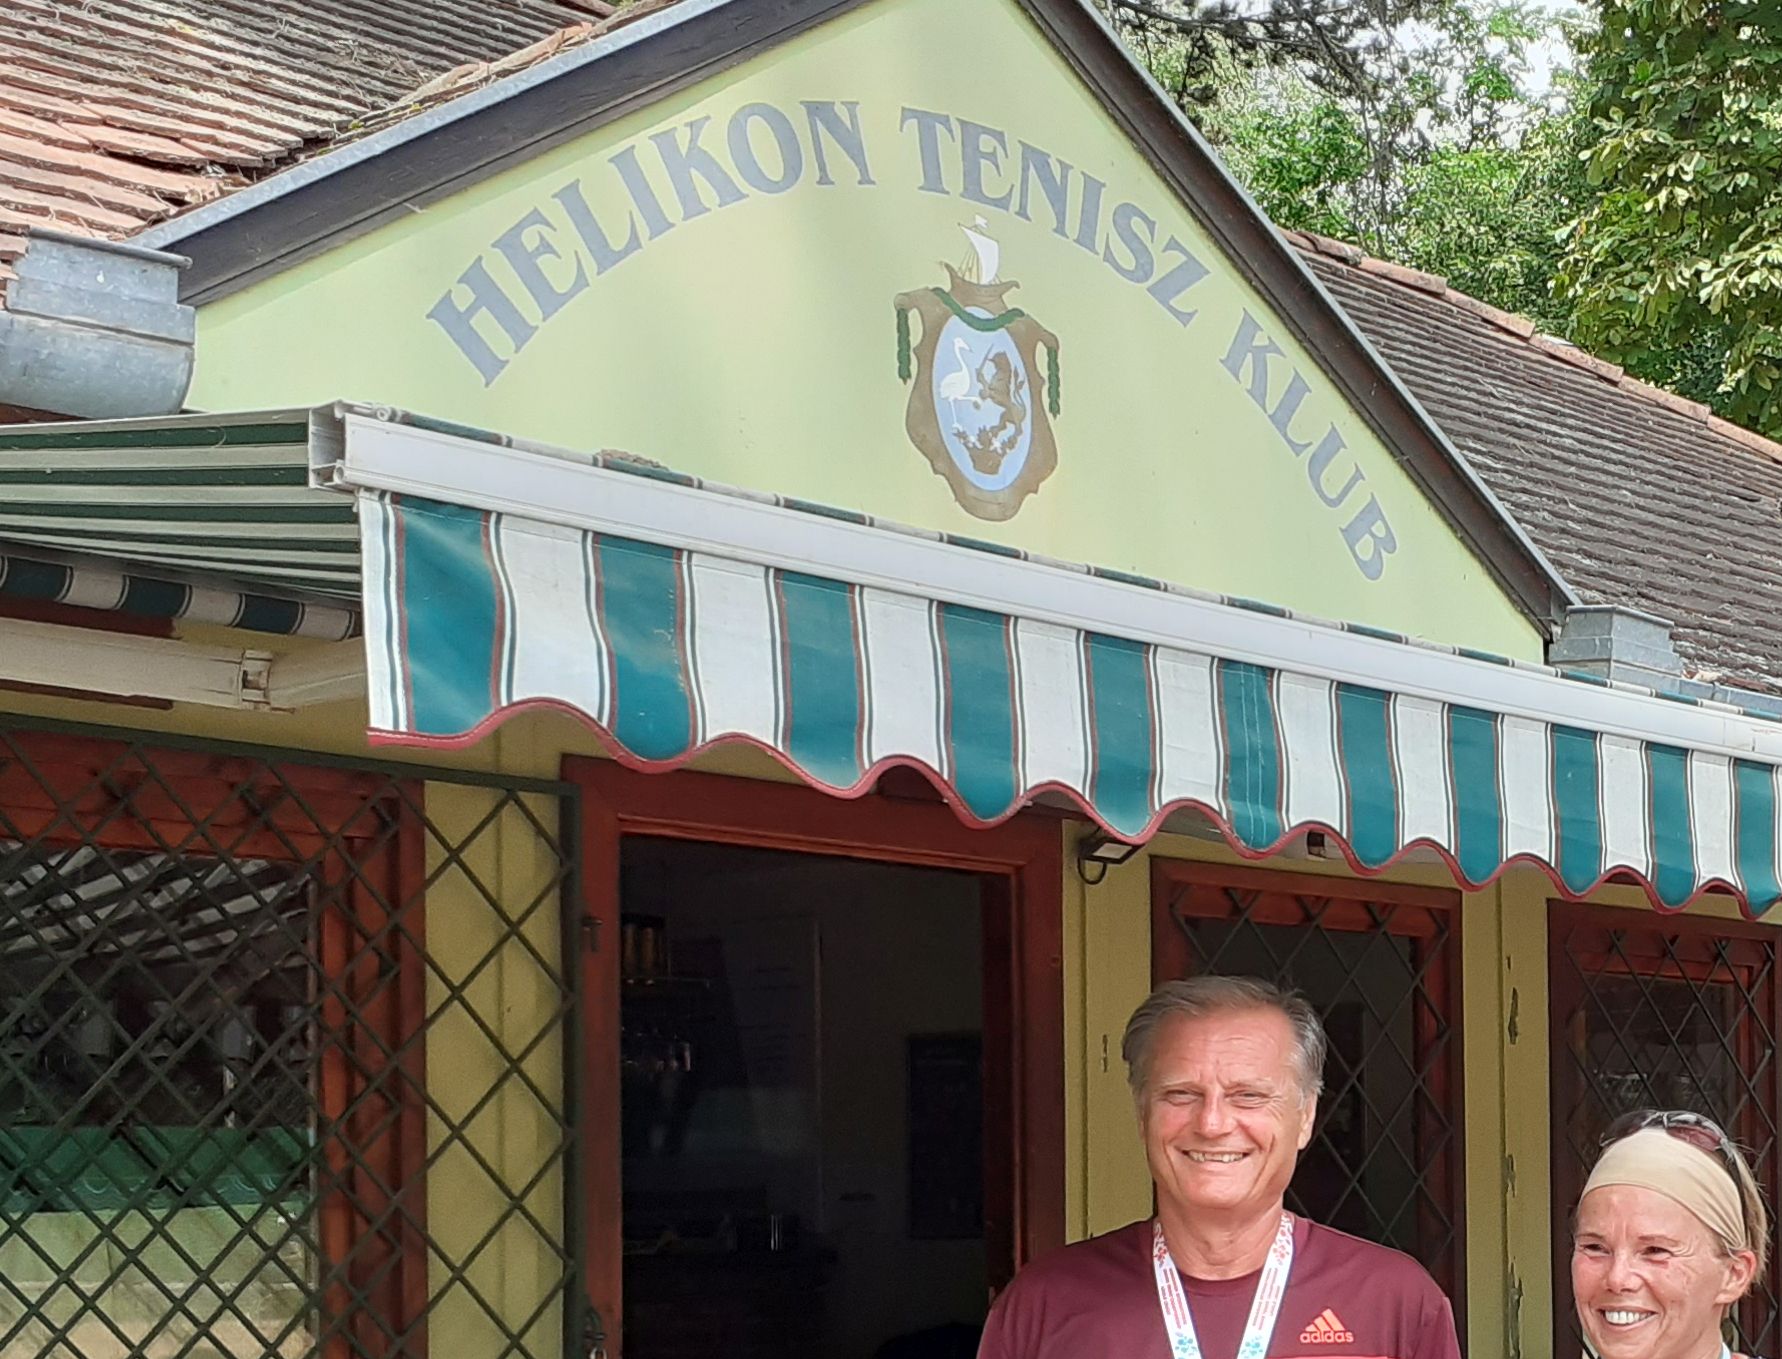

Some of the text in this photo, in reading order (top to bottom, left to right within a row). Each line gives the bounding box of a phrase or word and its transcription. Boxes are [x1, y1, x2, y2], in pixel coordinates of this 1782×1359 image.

[424, 100, 1399, 582] HELIKON TENISZ KLUB
[1299, 1329, 1355, 1343] adidas
